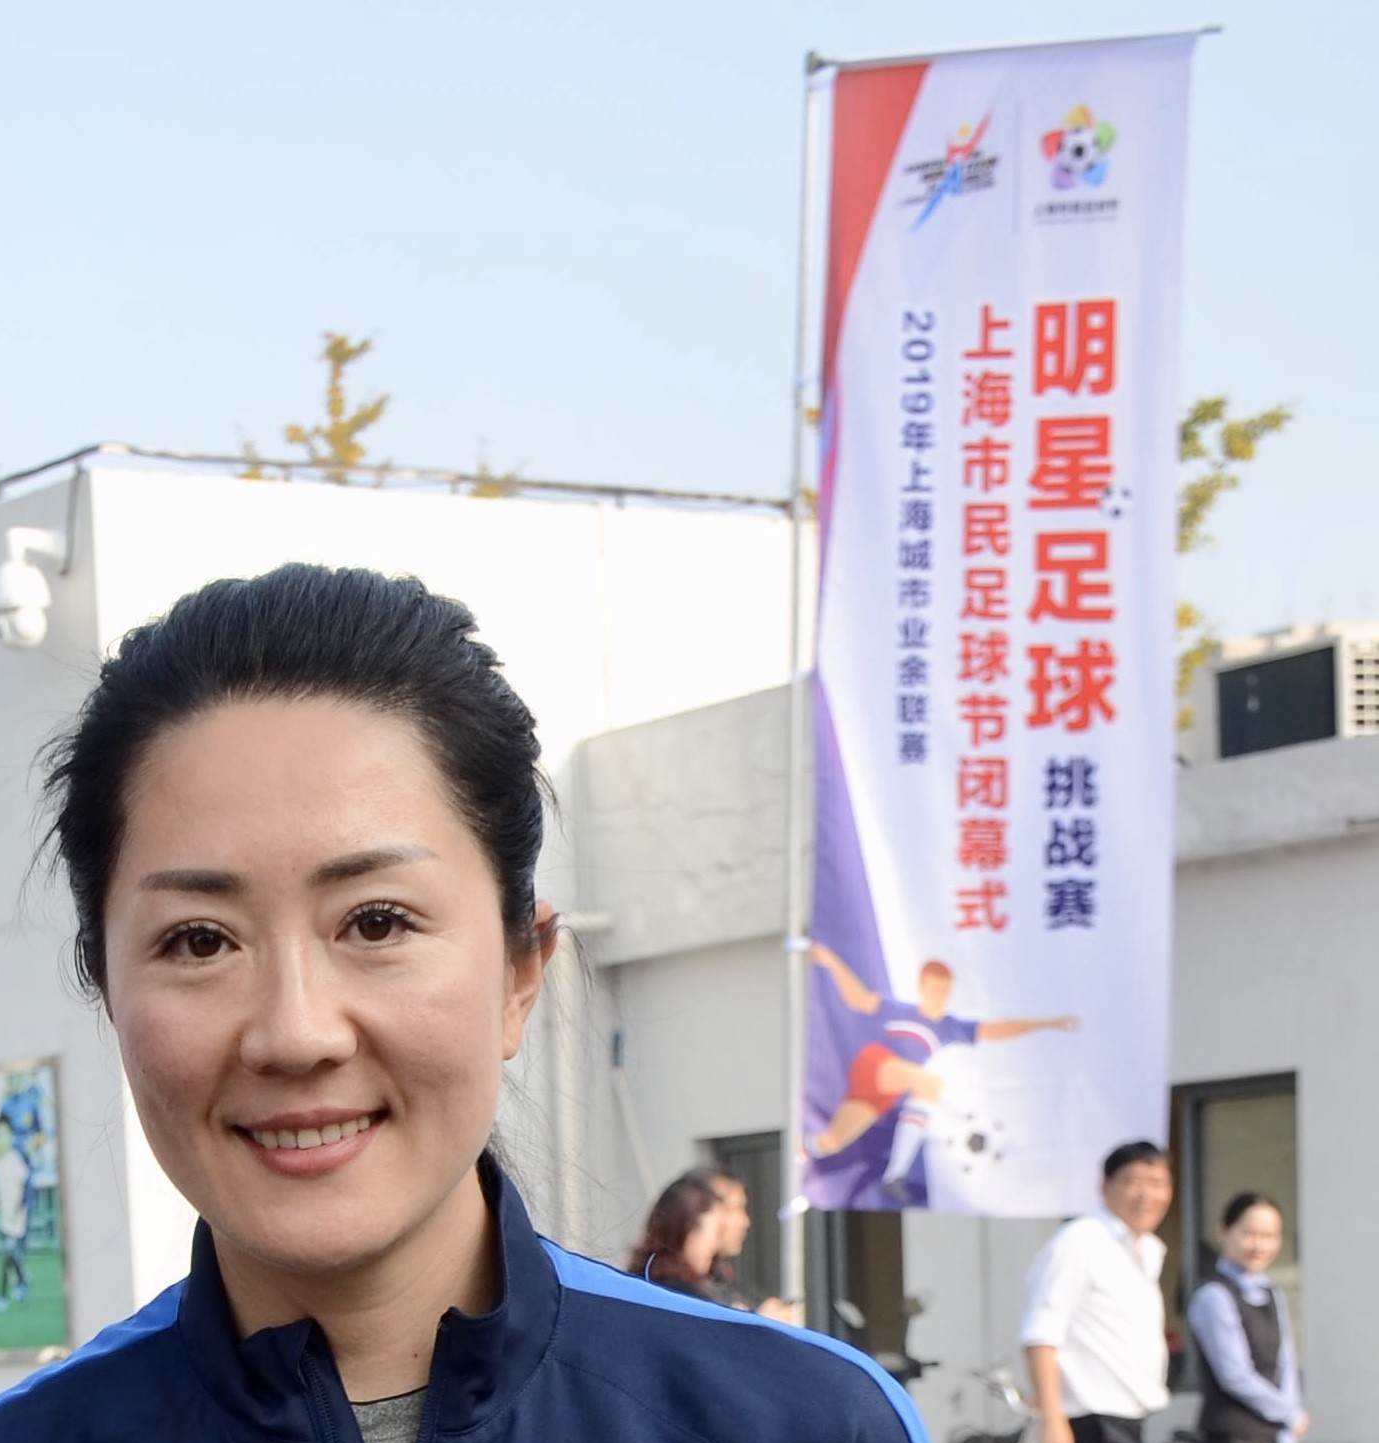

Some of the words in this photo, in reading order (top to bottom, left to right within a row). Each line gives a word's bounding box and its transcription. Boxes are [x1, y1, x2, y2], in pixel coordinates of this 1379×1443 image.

[953, 303, 1015, 933] 上海市民足球节闭幕式
[1027, 298, 1118, 731] 明星足球
[1042, 756, 1101, 931] 挑战赛
